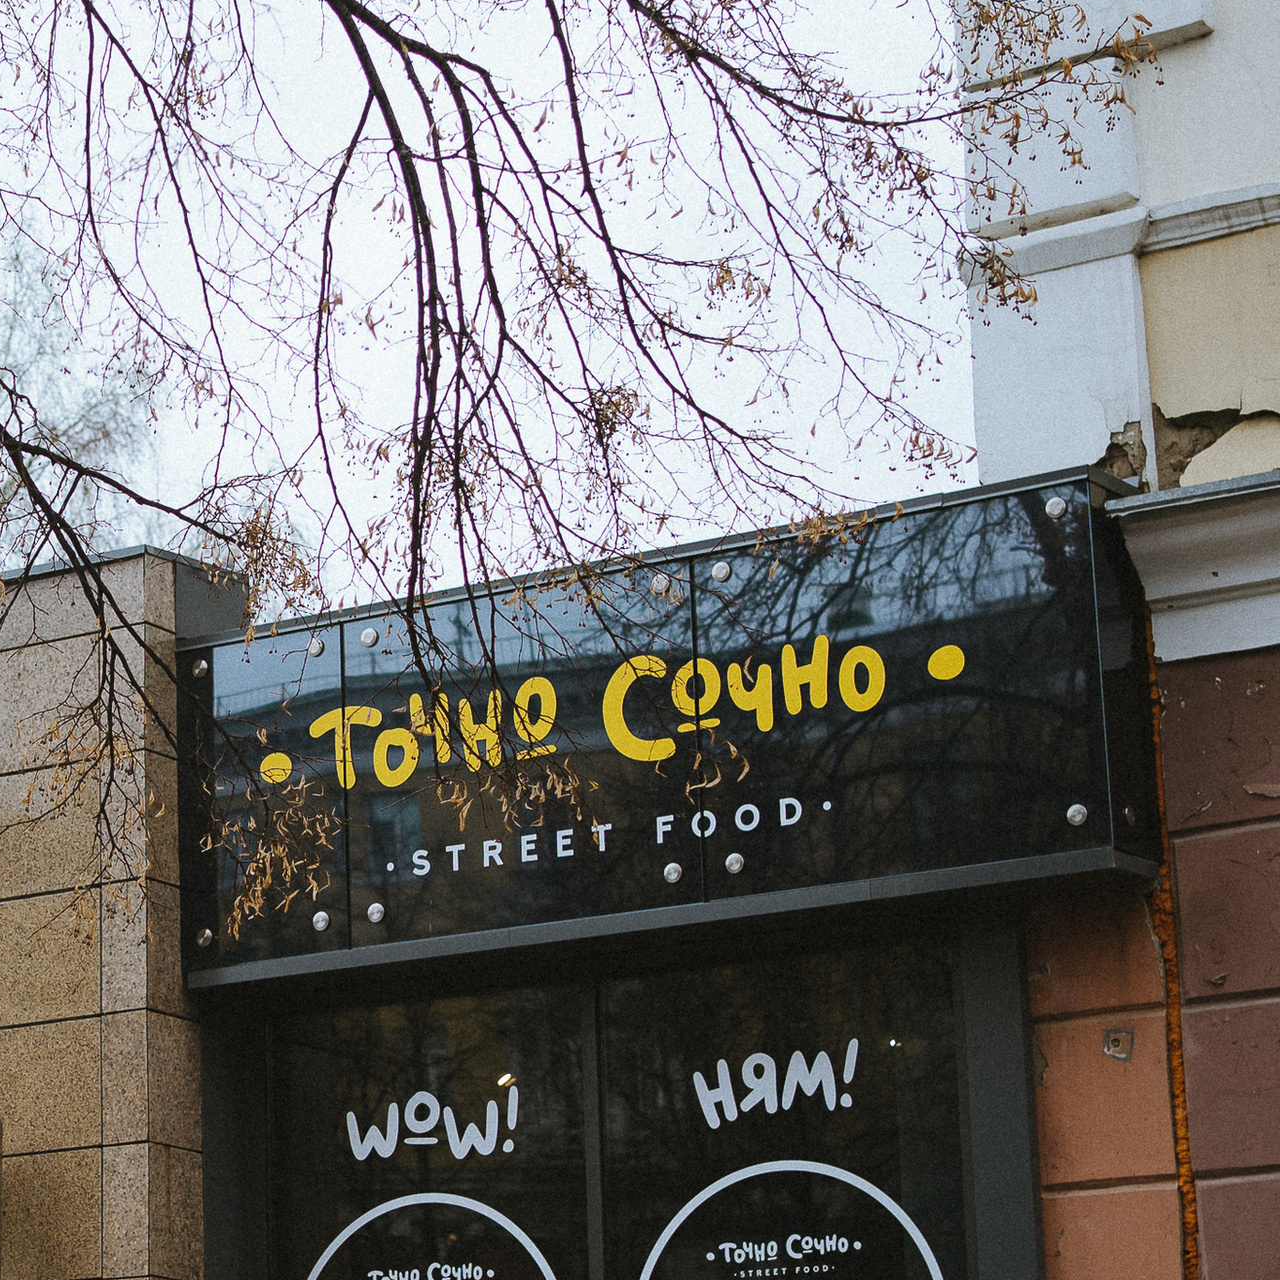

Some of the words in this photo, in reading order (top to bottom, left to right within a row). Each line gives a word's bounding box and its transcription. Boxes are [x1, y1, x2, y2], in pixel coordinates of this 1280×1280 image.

[412, 823, 612, 876] STREET
[656, 797, 805, 844] FOOD
[692, 1038, 859, 1129] НЯМ!
[740, 1267, 787, 1278] STREET
[795, 1265, 829, 1274] FOOD
